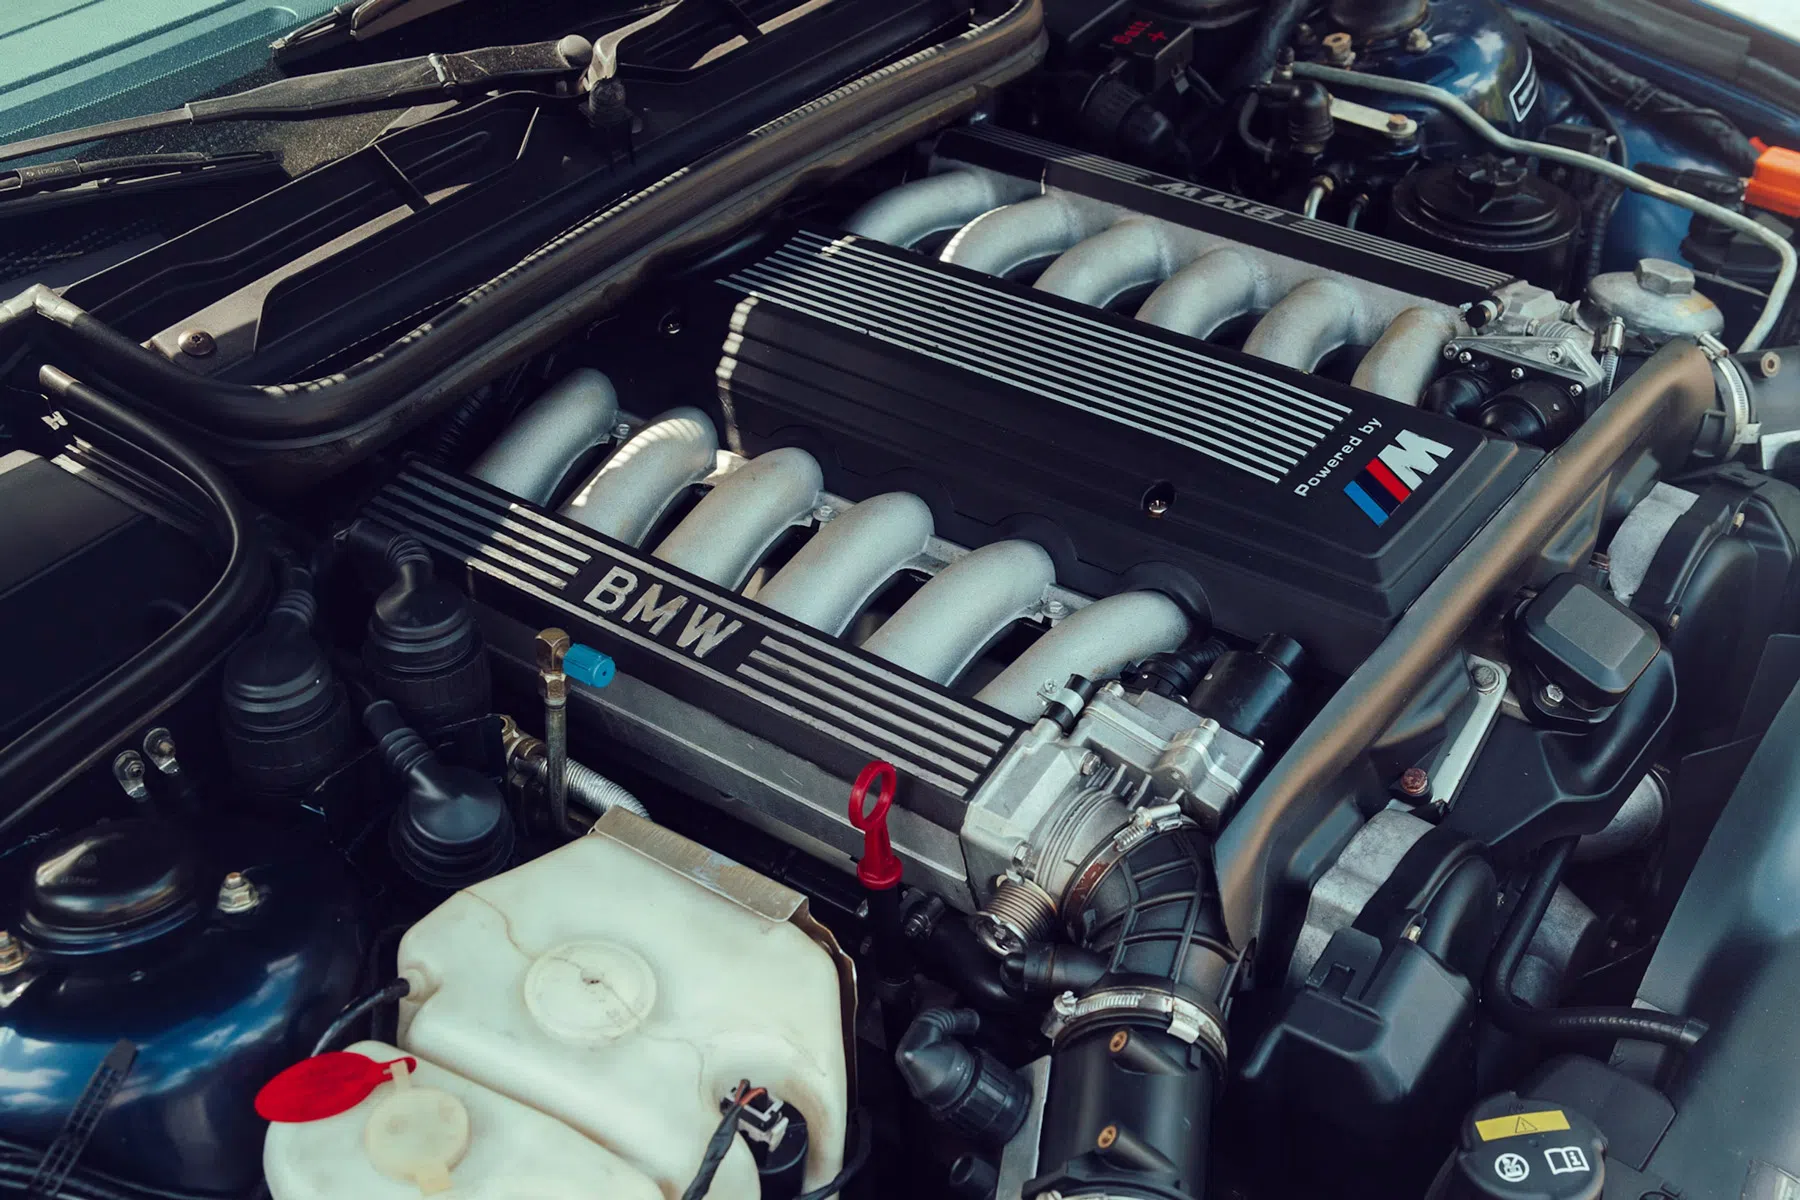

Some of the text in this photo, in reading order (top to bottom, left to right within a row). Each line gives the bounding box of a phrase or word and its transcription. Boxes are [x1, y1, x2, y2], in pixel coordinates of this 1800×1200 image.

[1152, 182, 1285, 220] BMW
[1294, 418, 1383, 497] Powered by
[1377, 429, 1454, 491] M
[583, 565, 744, 658] BMW
